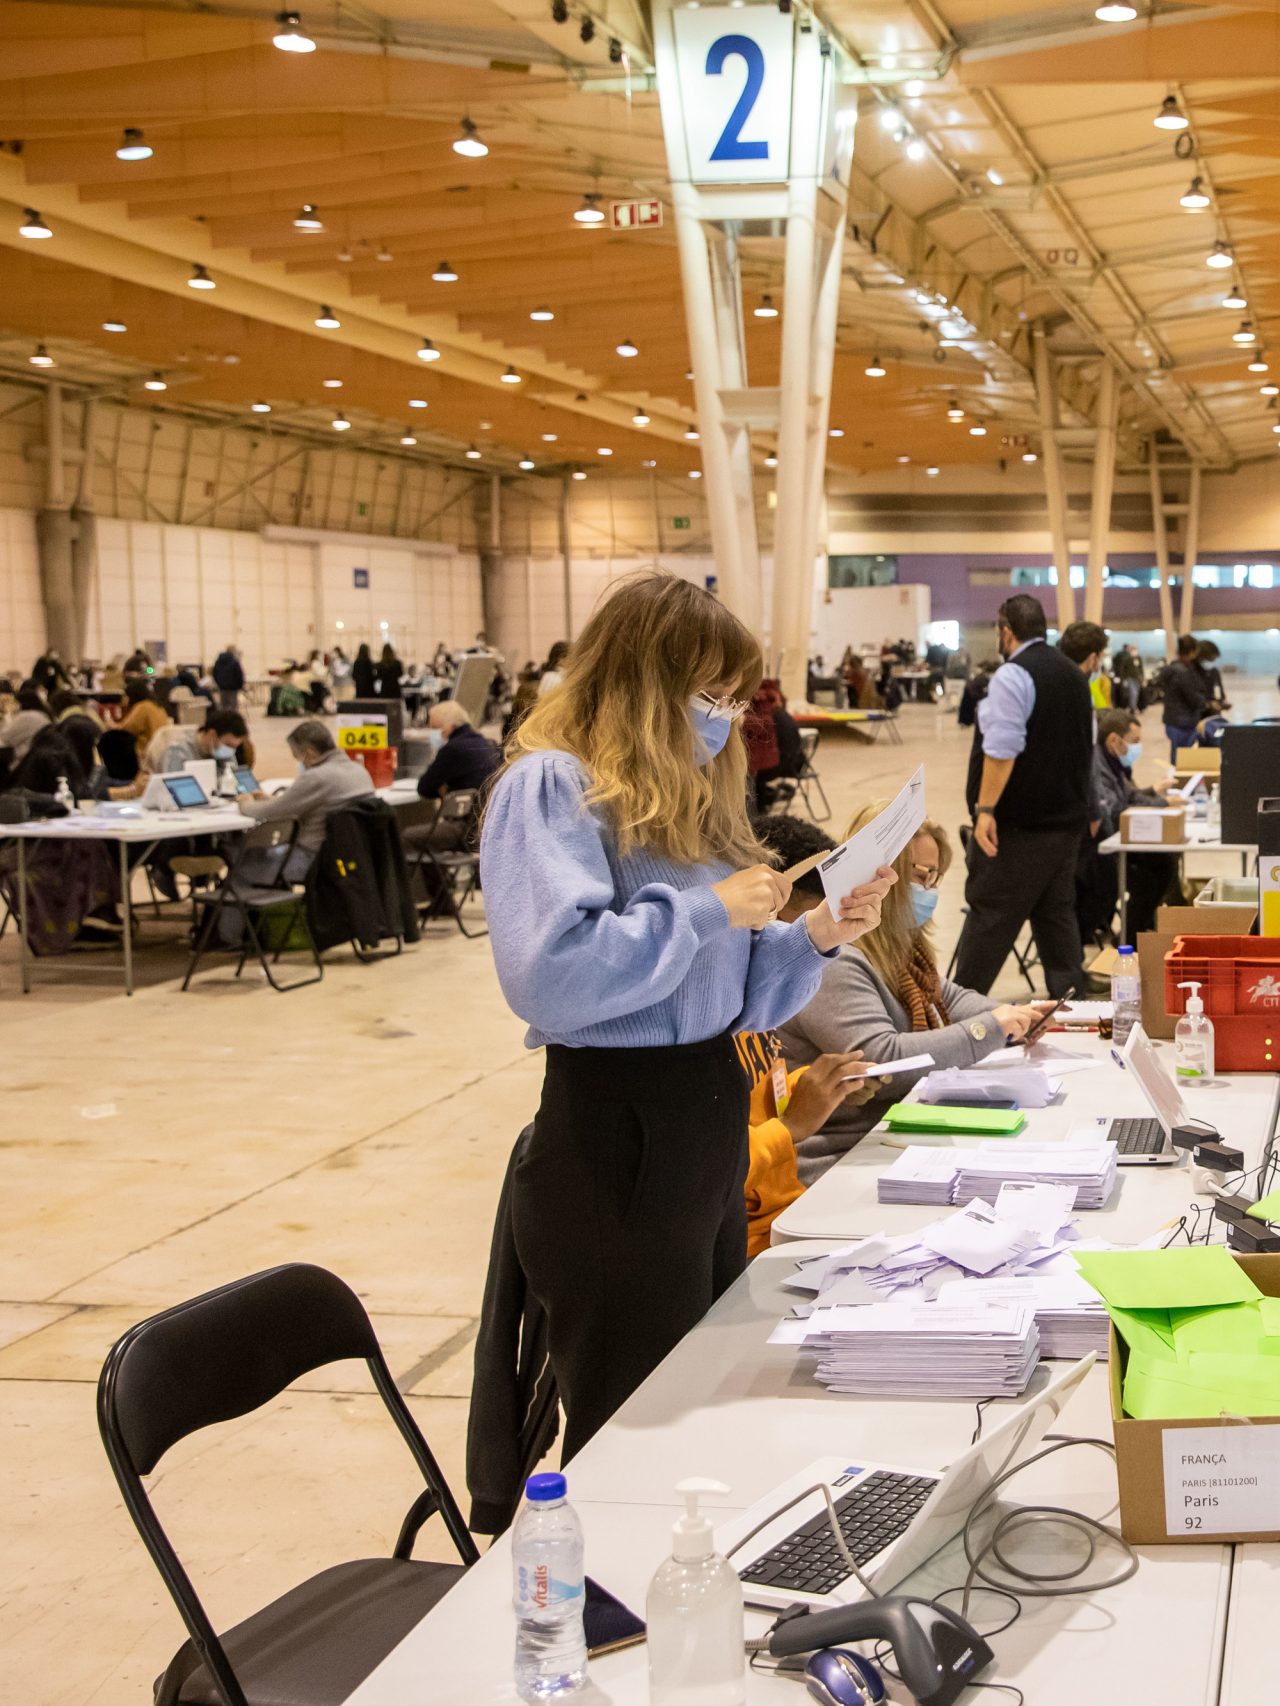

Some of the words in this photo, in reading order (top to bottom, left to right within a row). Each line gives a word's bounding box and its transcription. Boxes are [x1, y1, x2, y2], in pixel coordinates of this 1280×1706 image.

[705, 33, 769, 162] 2
[345, 731, 380, 747] 045
[1181, 1453, 1227, 1466] FRANÇA
[1182, 1479, 1207, 1488] PARIS
[1209, 1476, 1258, 1488] [81101200]
[1184, 1494, 1219, 1508] Paris
[1184, 1516, 1203, 1529] 92
